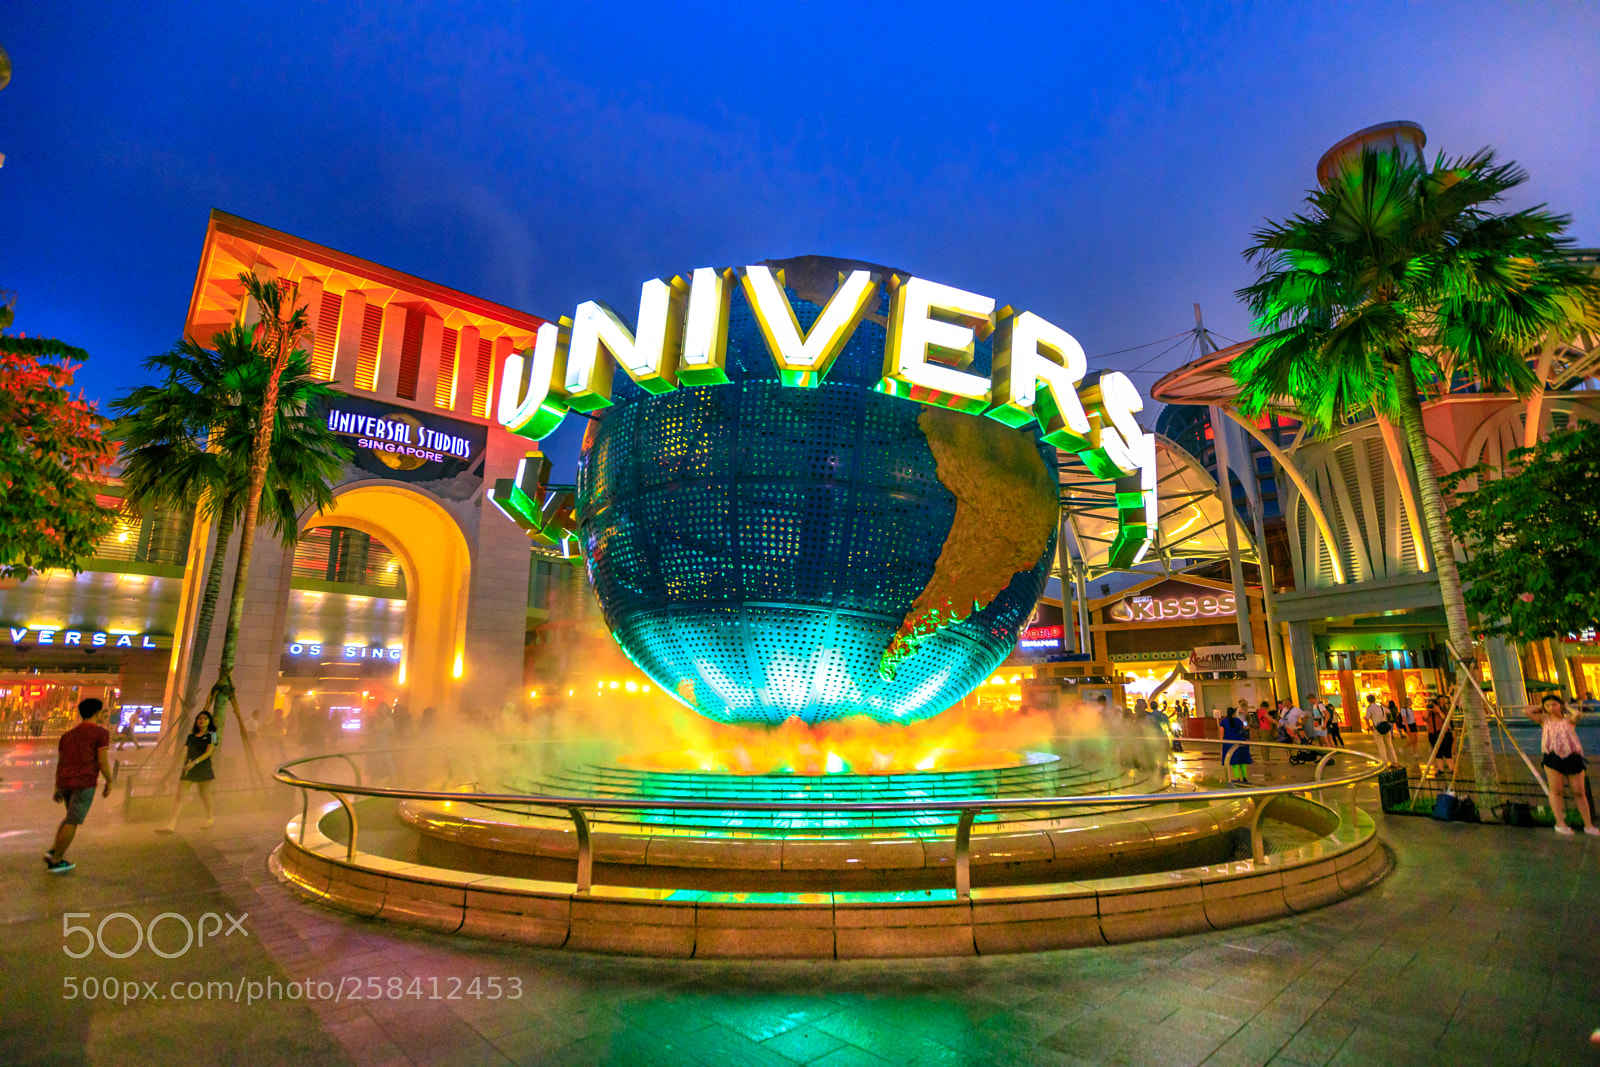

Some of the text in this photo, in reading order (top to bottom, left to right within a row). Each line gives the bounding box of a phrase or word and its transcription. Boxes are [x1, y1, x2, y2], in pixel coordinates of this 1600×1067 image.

[327, 409, 471, 459] UNIVERSAL STUDIOS
[358, 438, 444, 463] SINGAPORE
[10, 627, 156, 649] VERSAL
